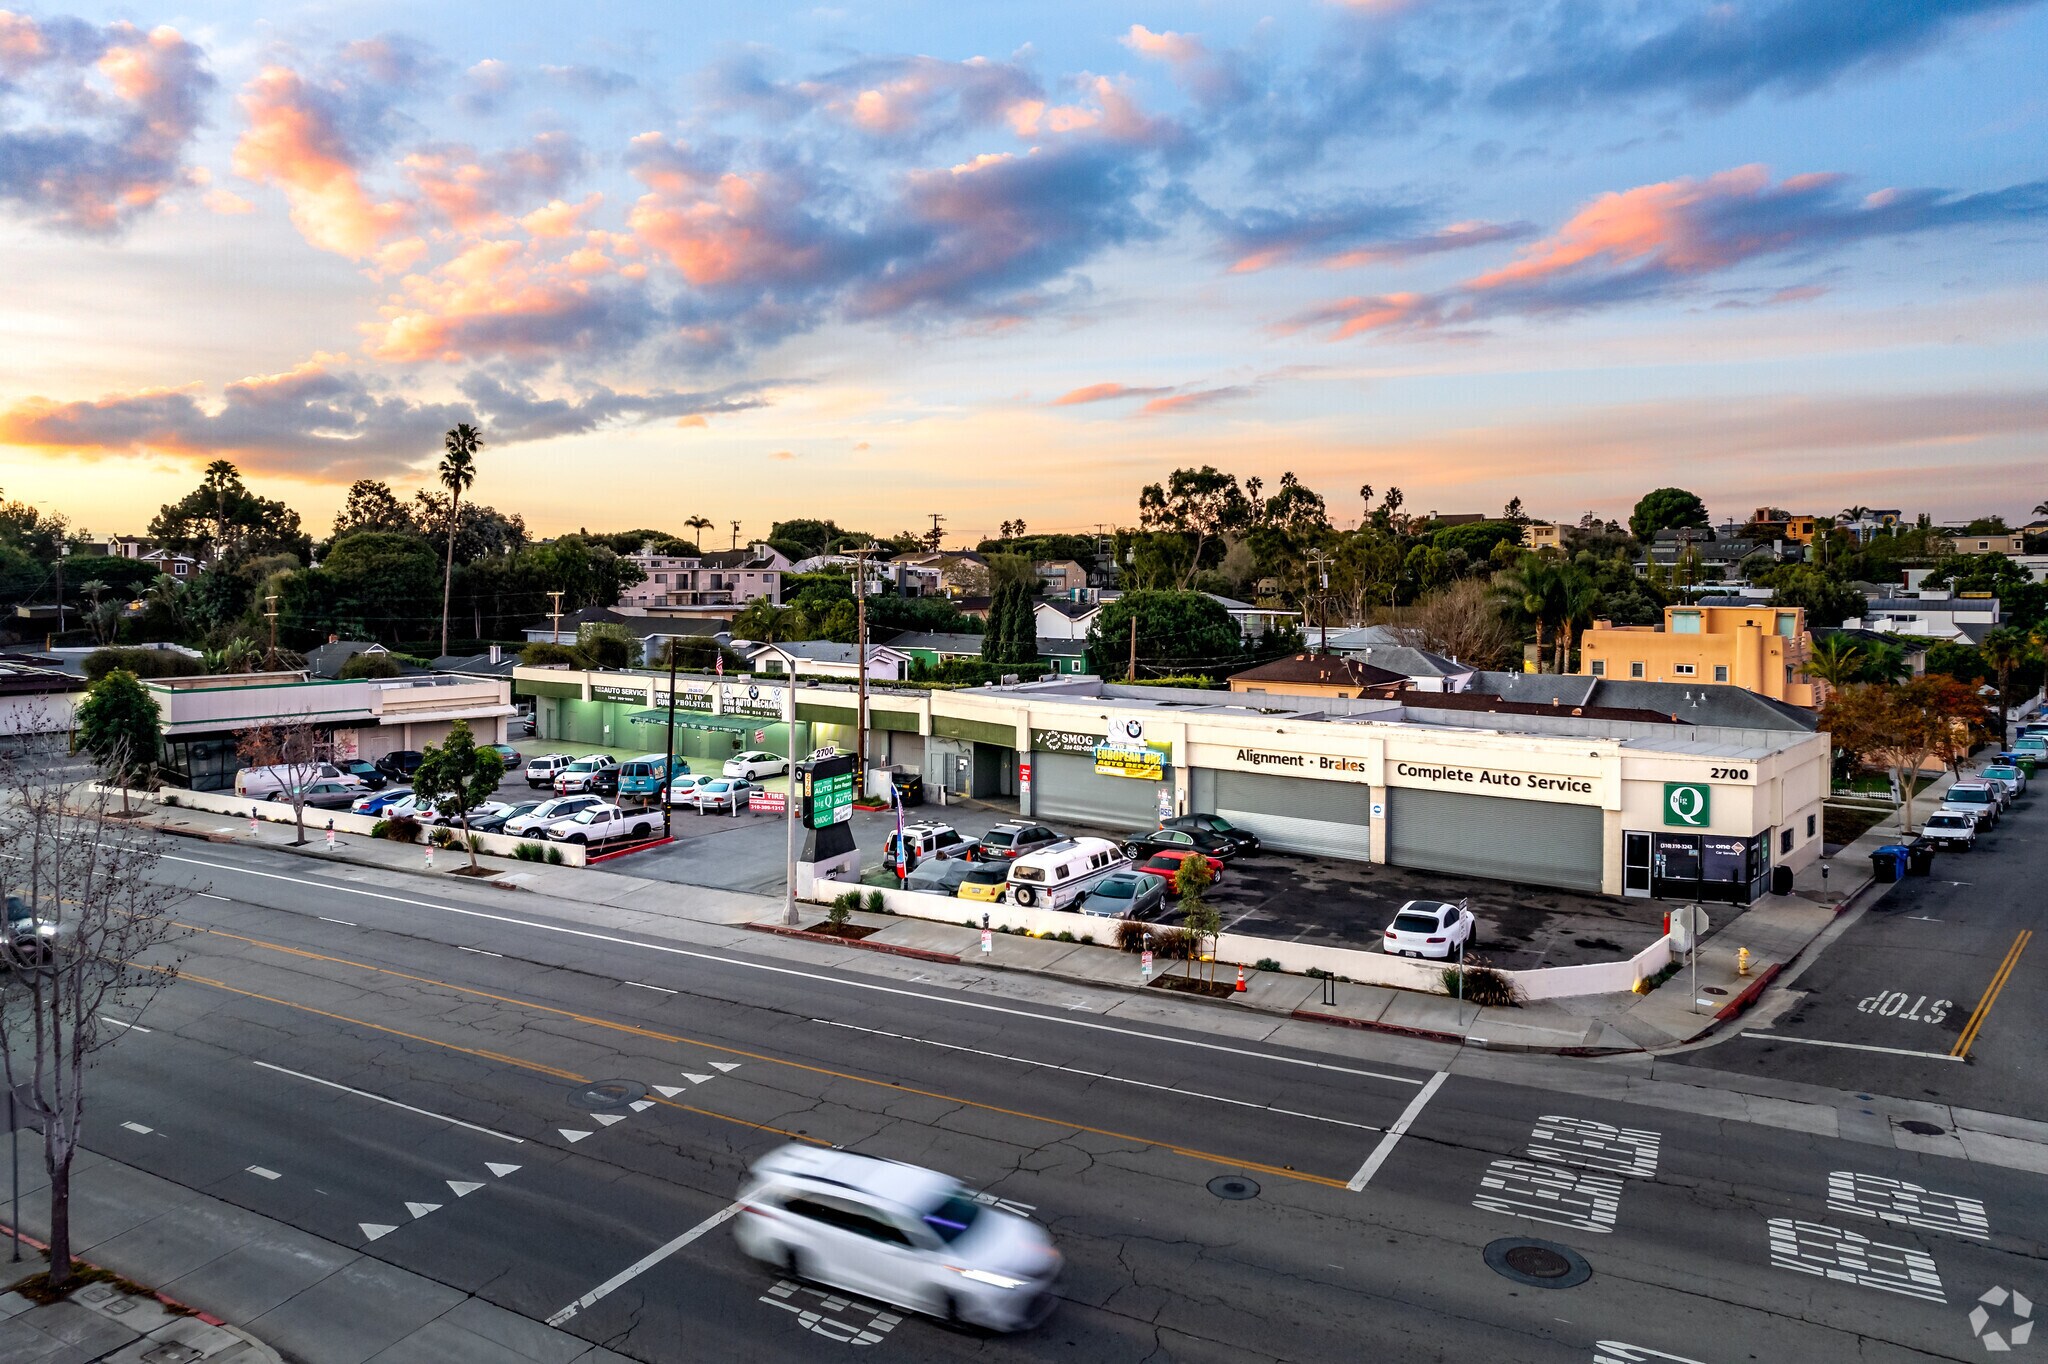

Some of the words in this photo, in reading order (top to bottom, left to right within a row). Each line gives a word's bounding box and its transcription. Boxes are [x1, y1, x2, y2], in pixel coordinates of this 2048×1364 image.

[675, 699, 714, 709] PHOLSTERY
[736, 698, 751, 707] AUTO
[1062, 733, 1093, 746] SMOG
[816, 747, 834, 758] 2700
[1097, 749, 1141, 763] EUROPEAN
[1237, 749, 1304, 766] Alignment
[1320, 757, 1365, 772] Brakes
[1397, 763, 1473, 782] Complete
[1479, 770, 1520, 787] Auto
[1527, 775, 1591, 793] Service
[1711, 767, 1749, 780] 2700
[814, 785, 832, 795] AUTO
[815, 799, 824, 808] big
[825, 795, 832, 808] Q
[834, 795, 852, 804] AUTO
[1670, 786, 1703, 825] Q
[1672, 796, 1688, 805] big
[1857, 990, 1953, 1024] STOP
[1526, 1115, 1661, 1177] CLEAR
[1472, 1160, 1624, 1234] CLEAR
[1826, 1171, 1990, 1240] KEEP
[1766, 1218, 1947, 1304] KEEP
